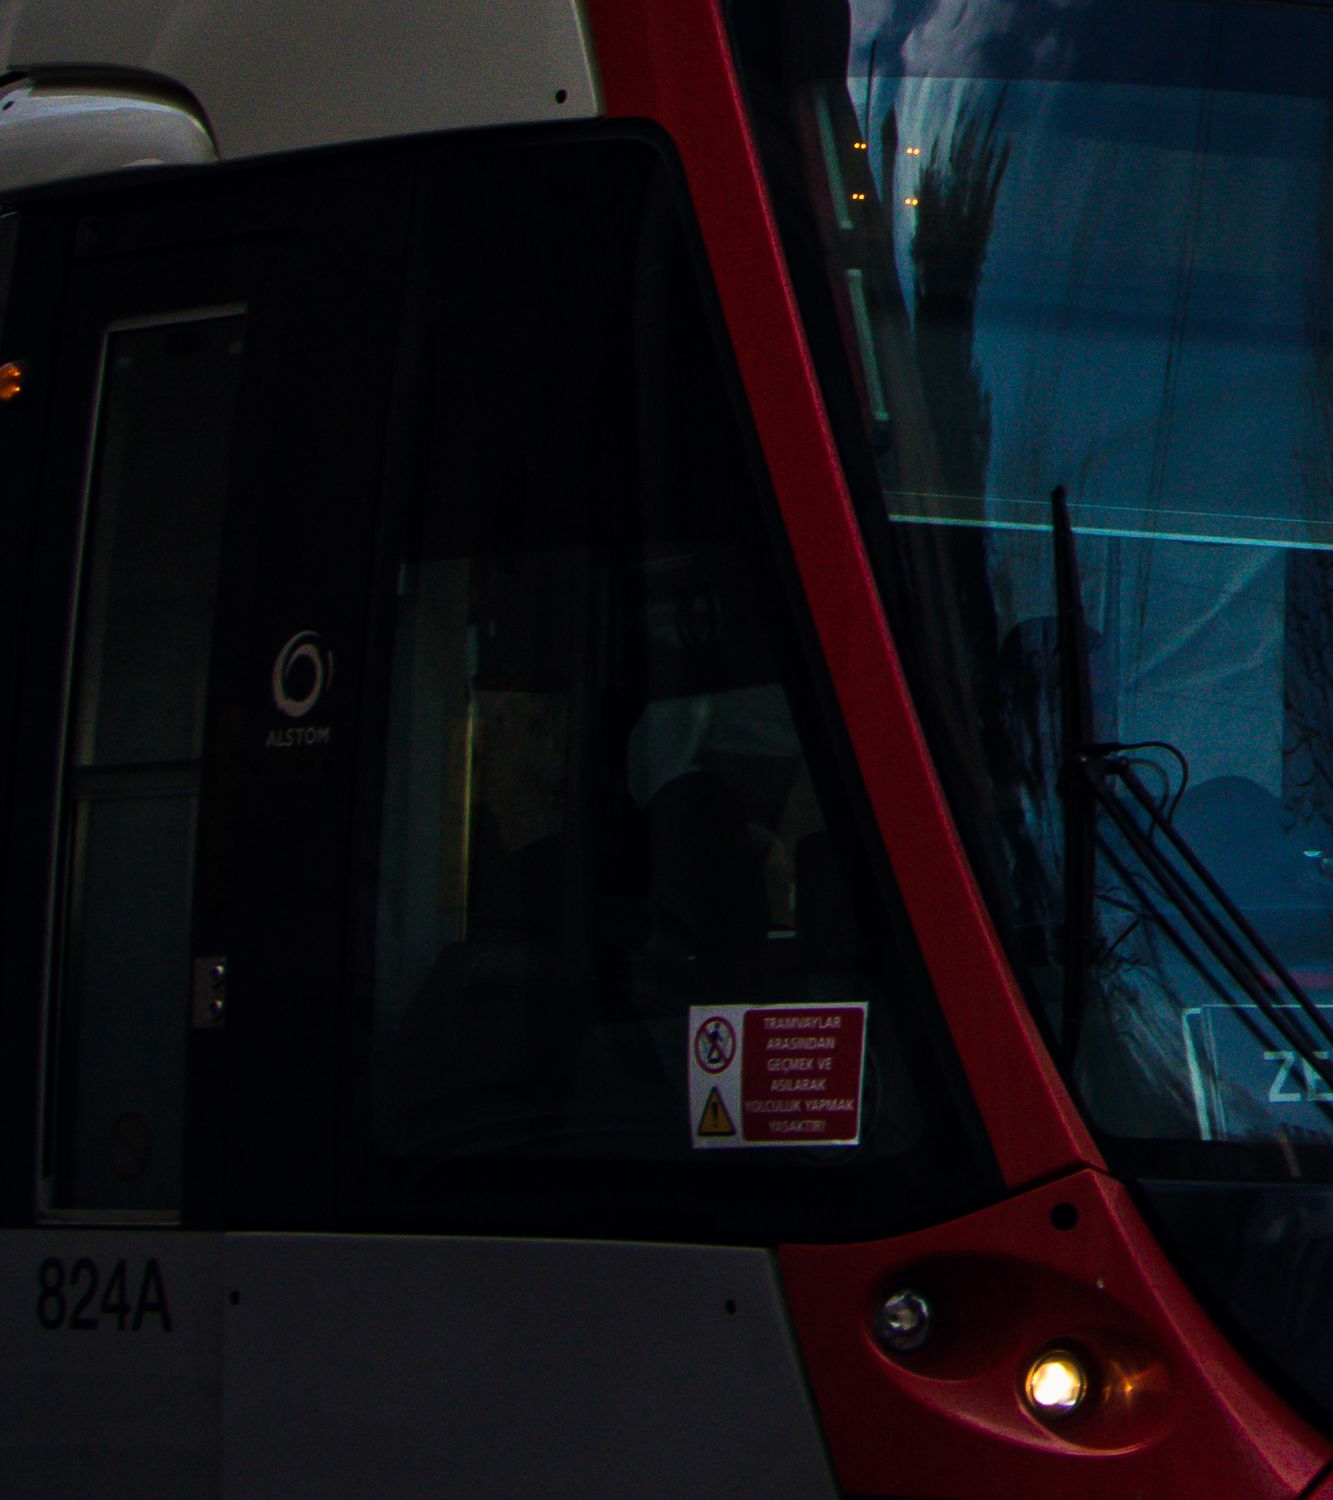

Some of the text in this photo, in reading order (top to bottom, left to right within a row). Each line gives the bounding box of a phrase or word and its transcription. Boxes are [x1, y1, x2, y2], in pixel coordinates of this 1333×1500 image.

[265, 725, 332, 748] ALSTOM
[763, 1015, 842, 1030] TRAMVAYLAR
[766, 1037, 835, 1051] ARASINDAN
[766, 1057, 833, 1074] GEÇMEK VE
[770, 1078, 827, 1092] ASILARAK
[744, 1098, 855, 1114] YOLCULUK YAPMAK
[39, 1257, 172, 1331] 824A
